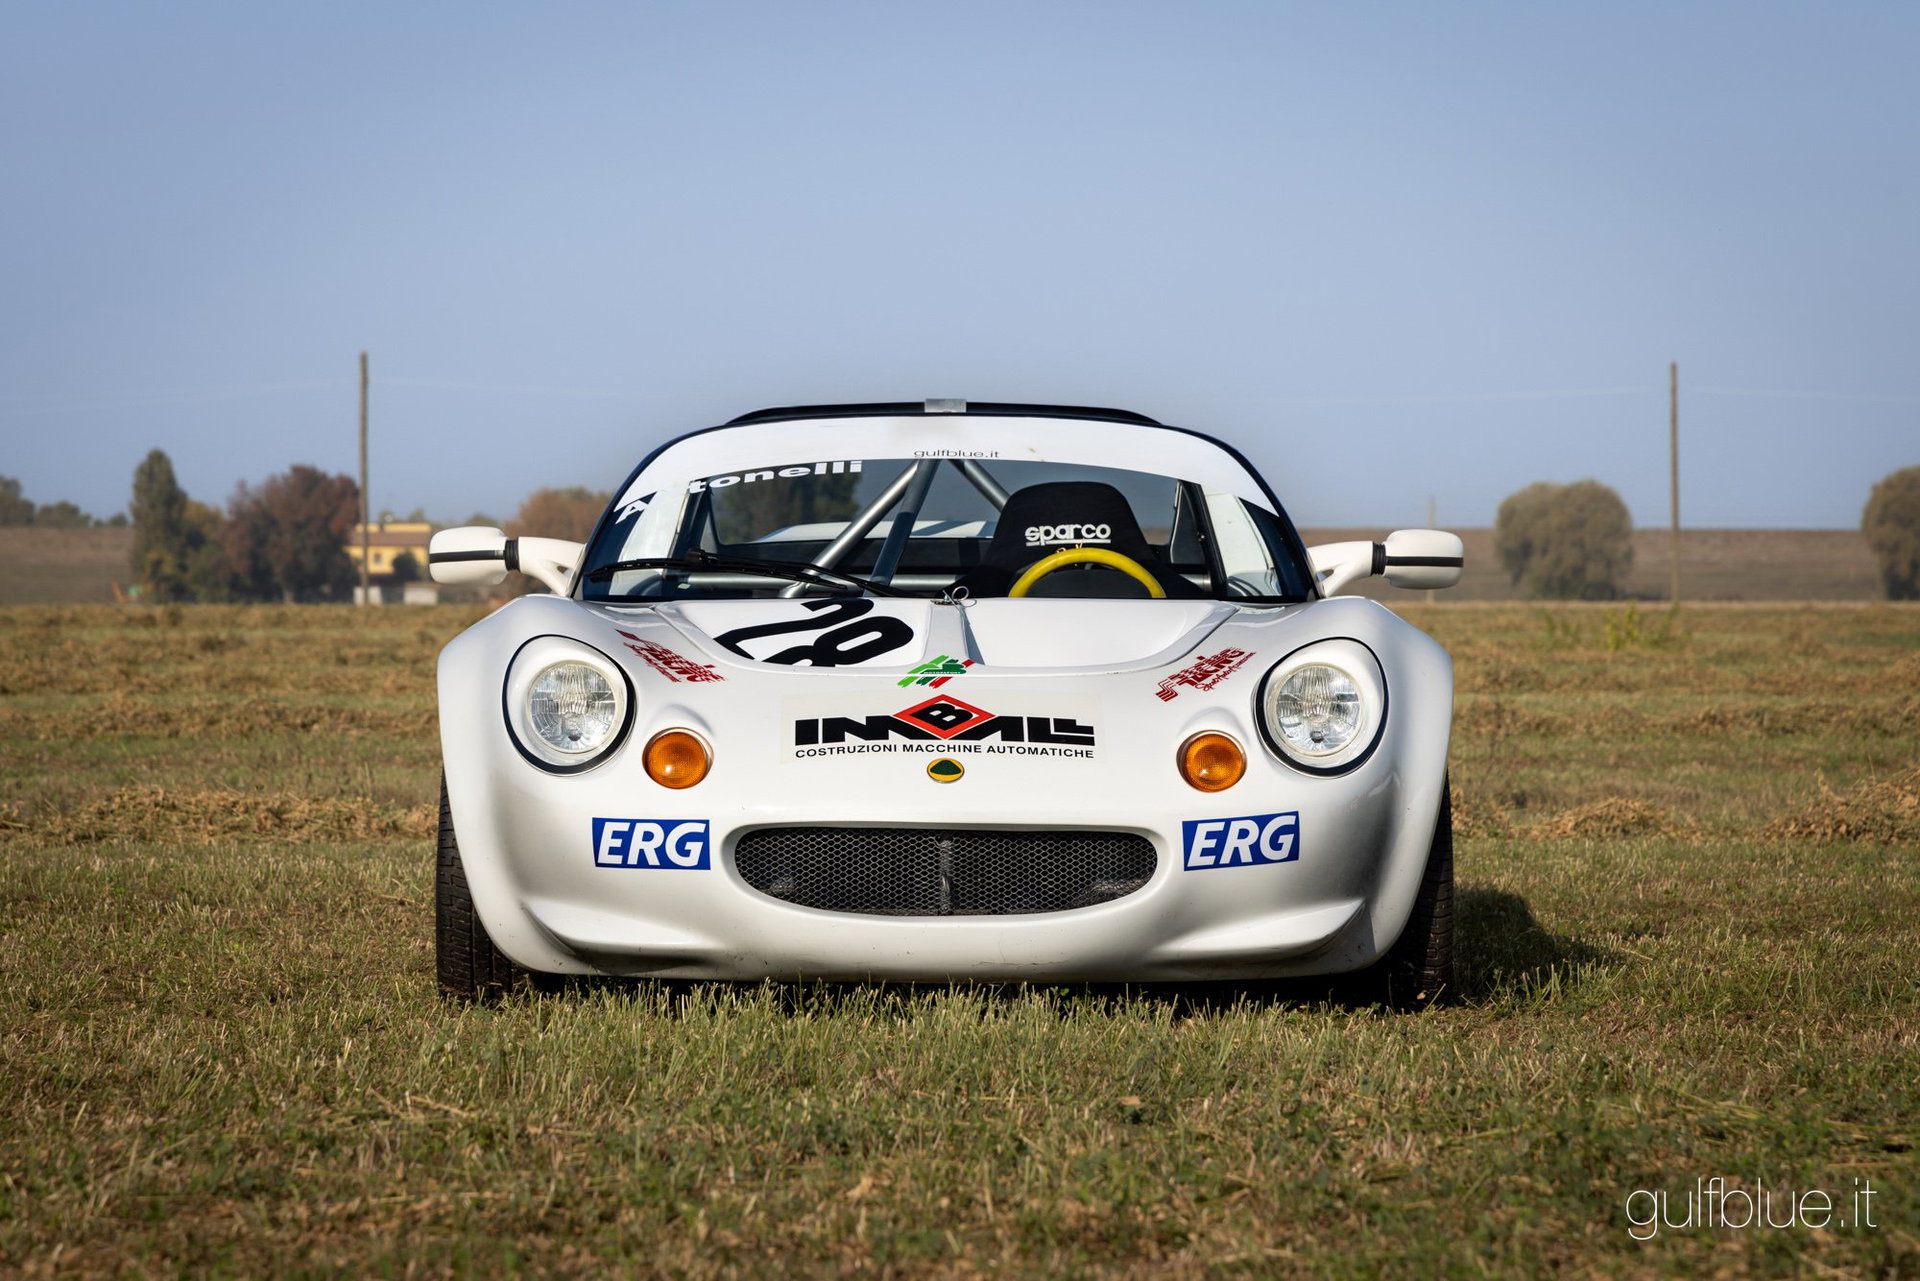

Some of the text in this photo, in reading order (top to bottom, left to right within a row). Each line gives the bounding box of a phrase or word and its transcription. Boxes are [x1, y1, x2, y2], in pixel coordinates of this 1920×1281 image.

[913, 449, 1000, 459] gulfblue.it
[614, 460, 863, 525] Atonelli
[1025, 523, 1112, 546] sparco
[795, 743, 1095, 759] COSTRUZIONI MACCHINE AUTOMATICHE
[597, 821, 707, 867] ERG
[1187, 814, 1297, 868] ERG
